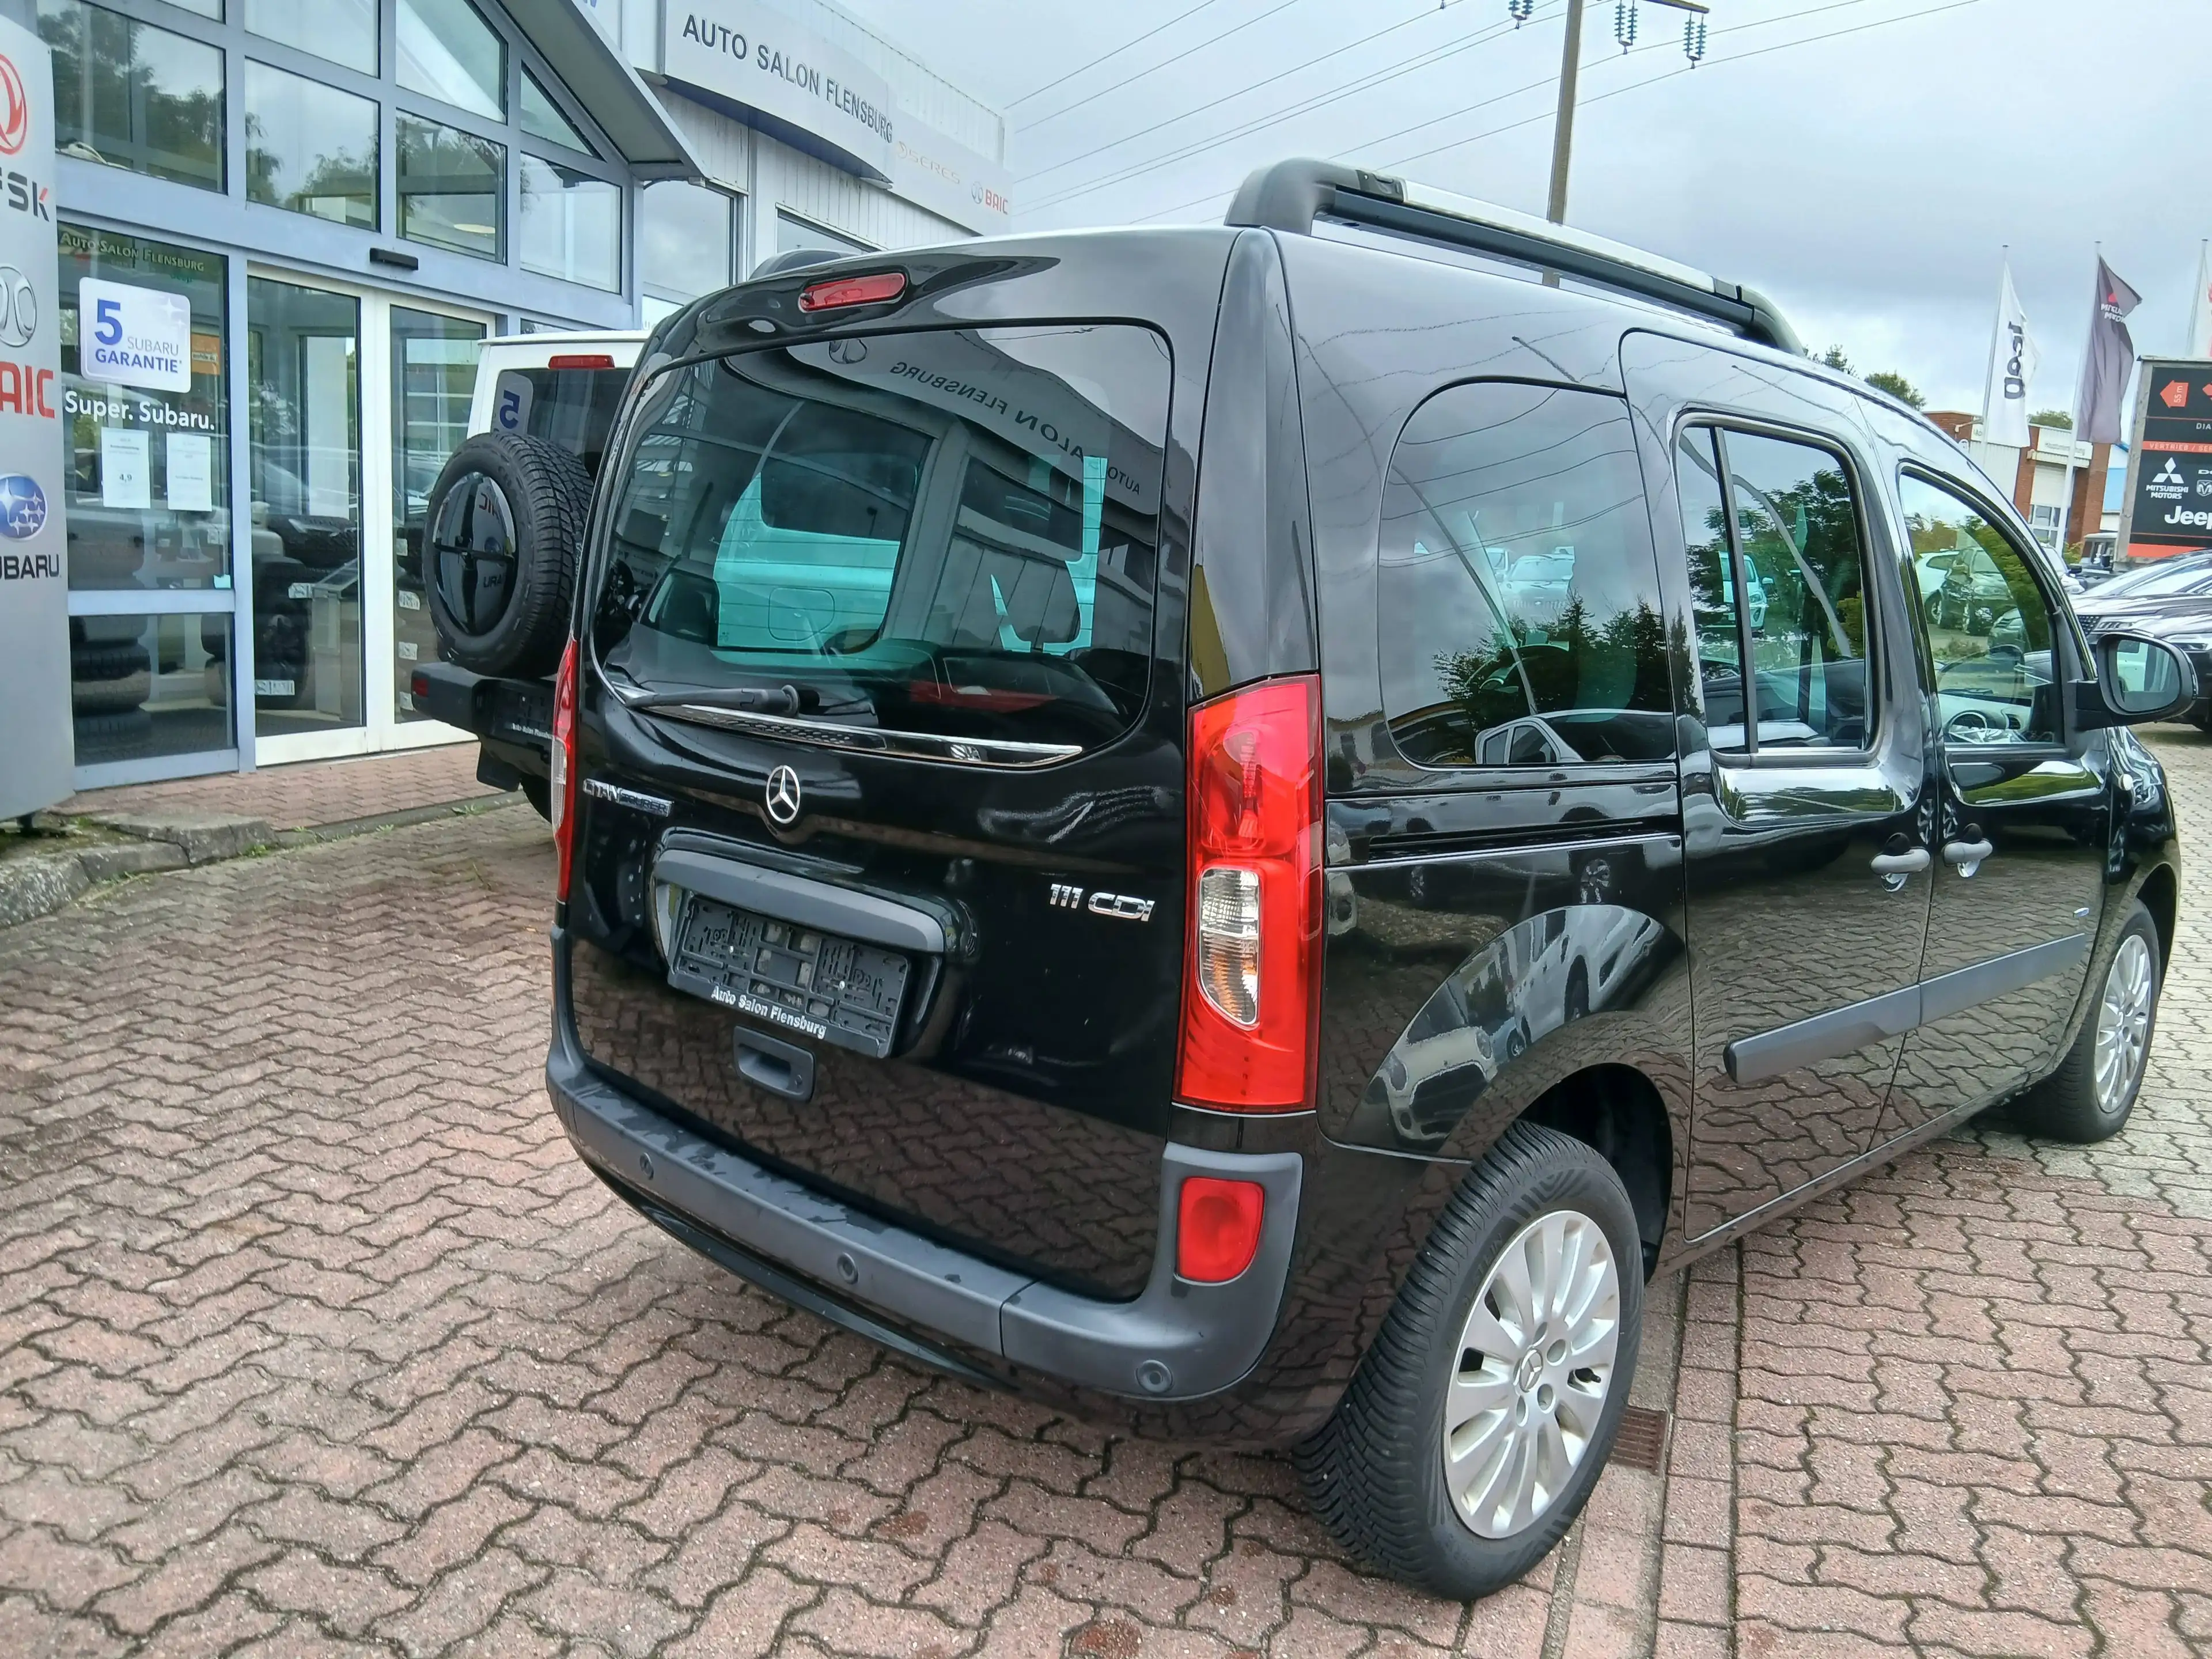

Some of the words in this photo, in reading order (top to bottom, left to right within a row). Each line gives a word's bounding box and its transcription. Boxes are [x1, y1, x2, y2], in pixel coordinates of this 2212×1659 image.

[683, 14, 748, 59] AUTO
[757, 44, 820, 96] SALON
[826, 78, 893, 144] FLENSBURG
[907, 149, 960, 184] SERES
[0, 167, 50, 222] SK
[986, 189, 1009, 215] BAIC
[60, 232, 96, 249] AUTO
[100, 241, 139, 258] SALON
[143, 249, 204, 272] FLENSBURG
[94, 298, 123, 346] 5
[127, 336, 179, 356] SUBARU
[65, 390, 134, 423] Super.
[139, 401, 215, 430] Subaru.
[2149, 442, 2189, 451] VERTRIEB
[2146, 484, 2189, 493] MITSUBISHI
[0, 554, 59, 580] BARU
[1050, 883, 1084, 909] 111
[1088, 892, 1156, 922] CDI
[710, 985, 736, 1005] Auto
[738, 994, 768, 1017] Salon
[770, 1005, 827, 1040] Flensburg
